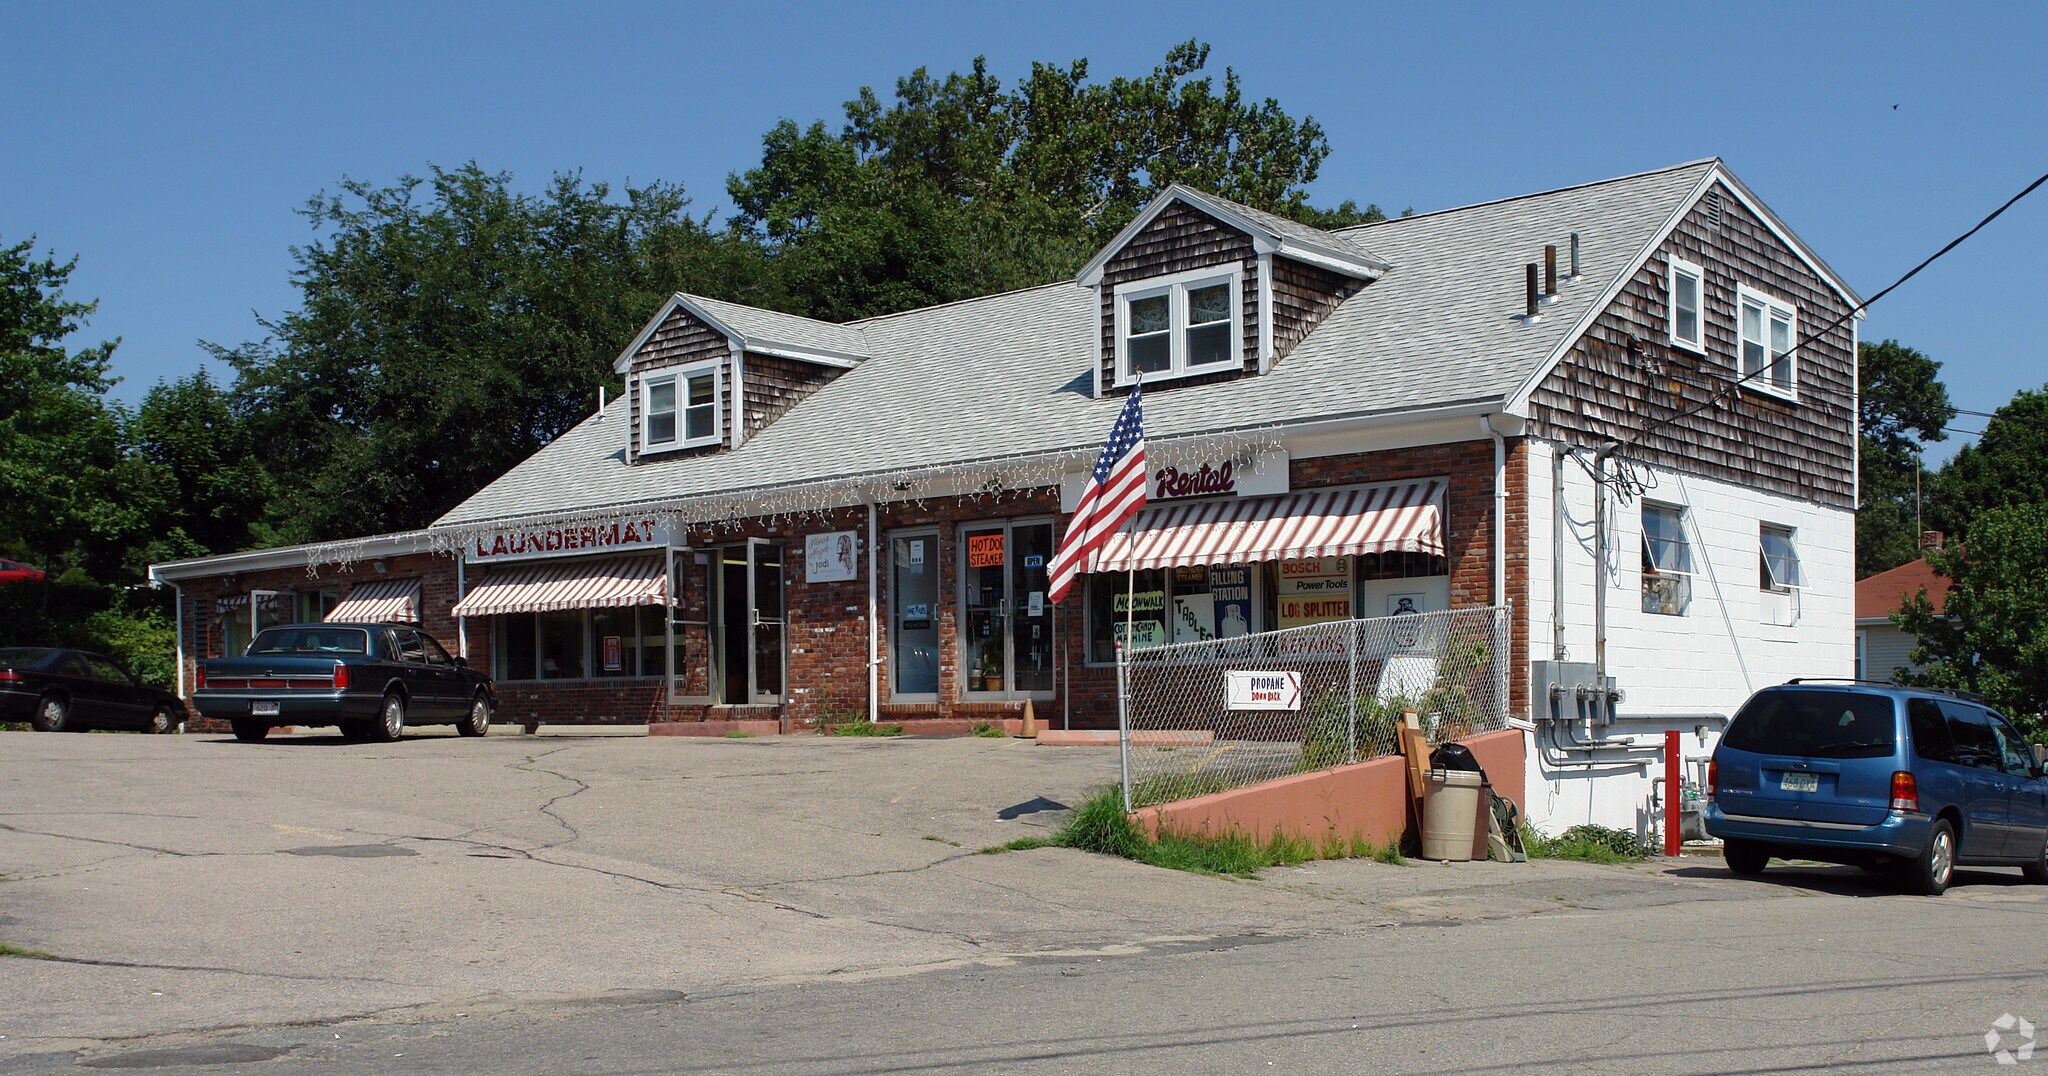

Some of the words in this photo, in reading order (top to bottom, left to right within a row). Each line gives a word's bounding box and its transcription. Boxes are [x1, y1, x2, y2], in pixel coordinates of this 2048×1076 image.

[1155, 460, 1235, 498] Rental
[476, 519, 656, 557] LAUNDERMAT
[971, 538, 989, 553] HOT
[970, 552, 1004, 566] STEAMER
[1027, 558, 1040, 566] OPEN
[1282, 562, 1320, 574] BOSCH
[1211, 570, 1244, 585] FILLING
[1296, 580, 1323, 591] Power
[1325, 579, 1348, 589] Tools
[1212, 586, 1248, 601] STATION
[1281, 602, 1301, 618] LOG
[1303, 601, 1349, 618] SPLITTER
[1116, 632, 1153, 643] MAHINE
[1250, 677, 1285, 691] PROPANE
[1251, 692, 1266, 701] DOWN
[1267, 691, 1281, 702] BACK
